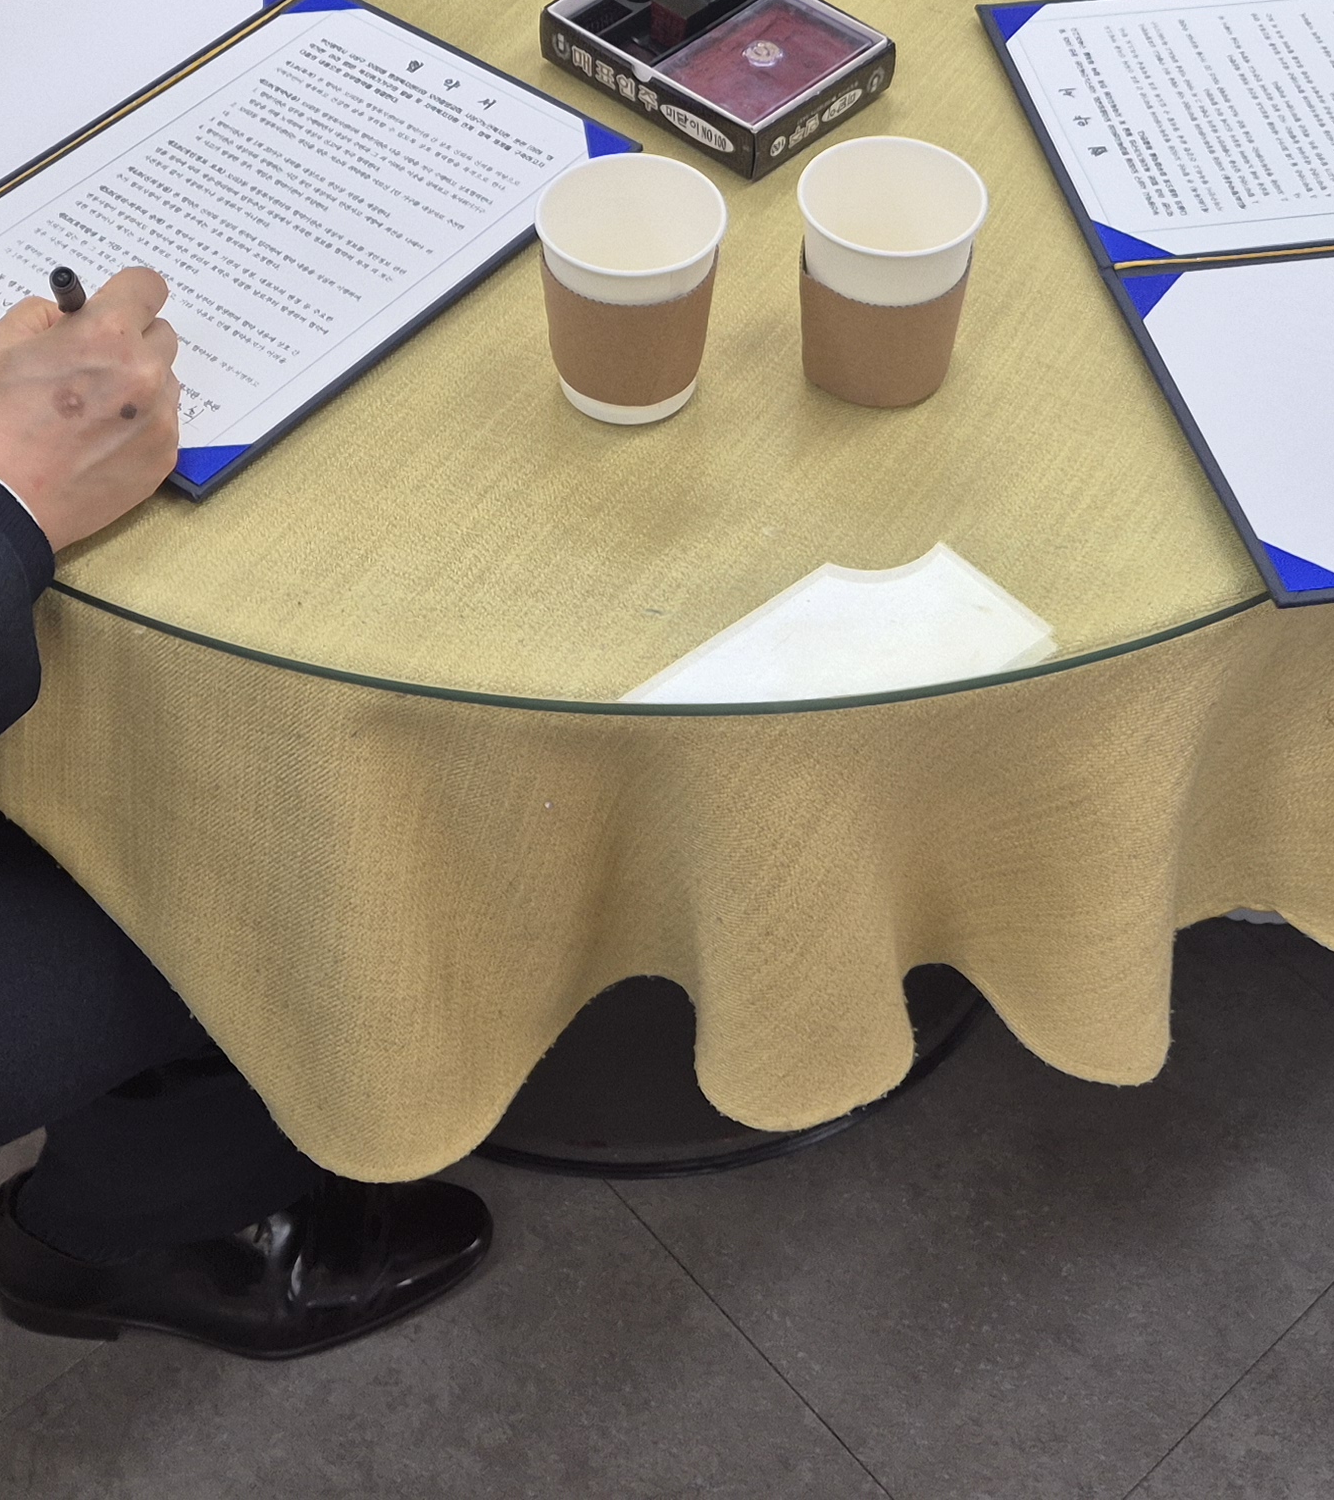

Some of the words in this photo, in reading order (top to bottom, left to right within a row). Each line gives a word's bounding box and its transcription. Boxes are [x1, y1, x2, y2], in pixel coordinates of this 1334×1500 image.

[571, 45, 658, 112] 매표인주
[477, 98, 497, 111] 서
[666, 105, 700, 136] 미단이
[701, 127, 713, 142] NO
[713, 132, 727, 151] 100
